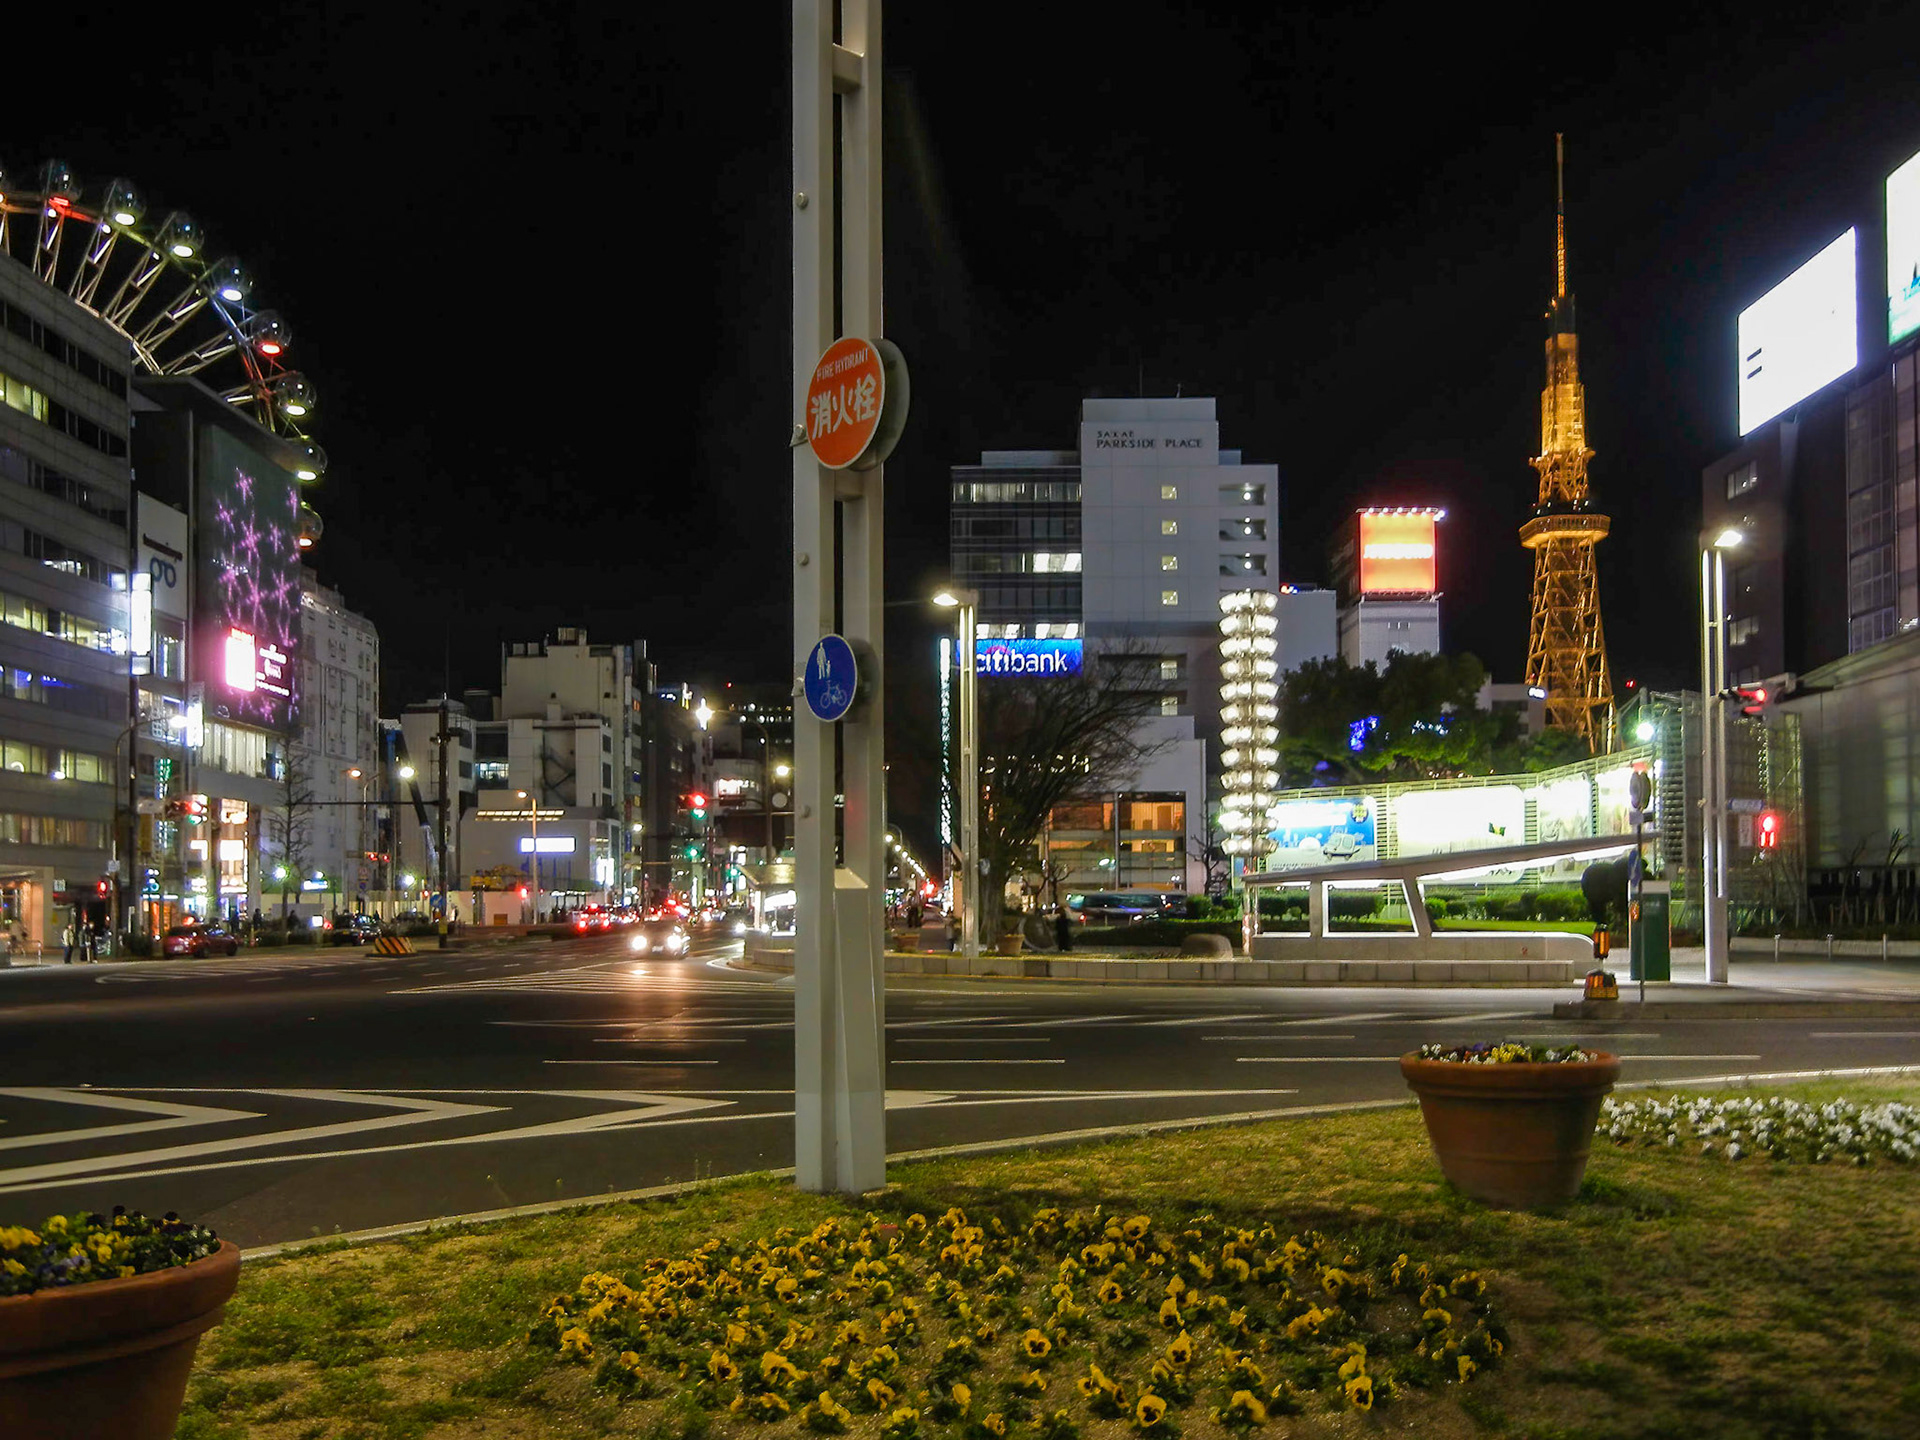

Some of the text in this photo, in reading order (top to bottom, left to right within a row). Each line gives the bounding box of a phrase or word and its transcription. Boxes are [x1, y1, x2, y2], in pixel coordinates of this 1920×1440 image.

[811, 373, 877, 440] 消火栓
[1096, 438, 1204, 449] PARKSIDE PLACE
[976, 648, 1068, 673] citibank
[979, 754, 1090, 774] CCH
